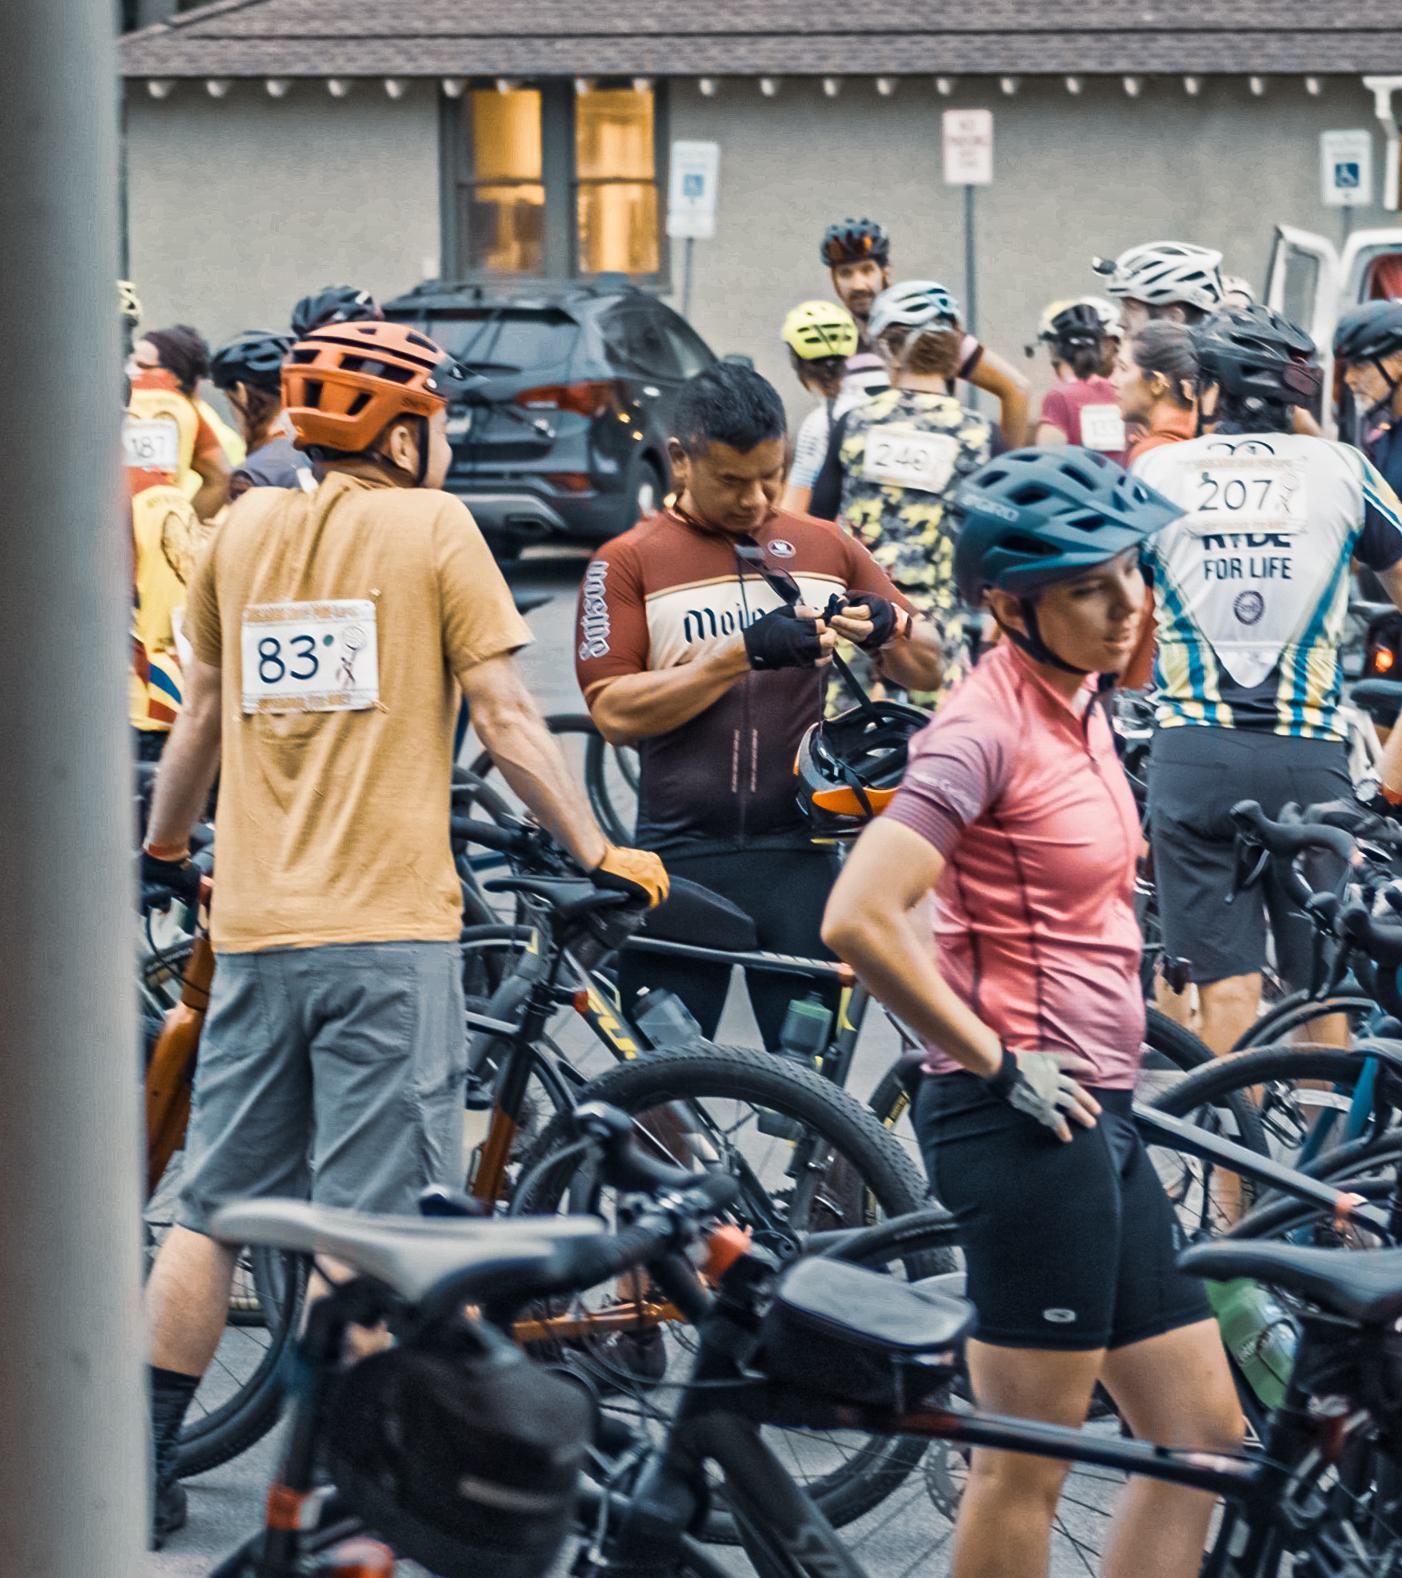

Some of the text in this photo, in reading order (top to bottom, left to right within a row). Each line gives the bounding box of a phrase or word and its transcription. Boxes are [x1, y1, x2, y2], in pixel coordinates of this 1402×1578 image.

[1197, 478, 1273, 512] 207
[1204, 557, 1242, 580] FOR
[1250, 557, 1292, 580] LIFE
[258, 634, 319, 684] 83
